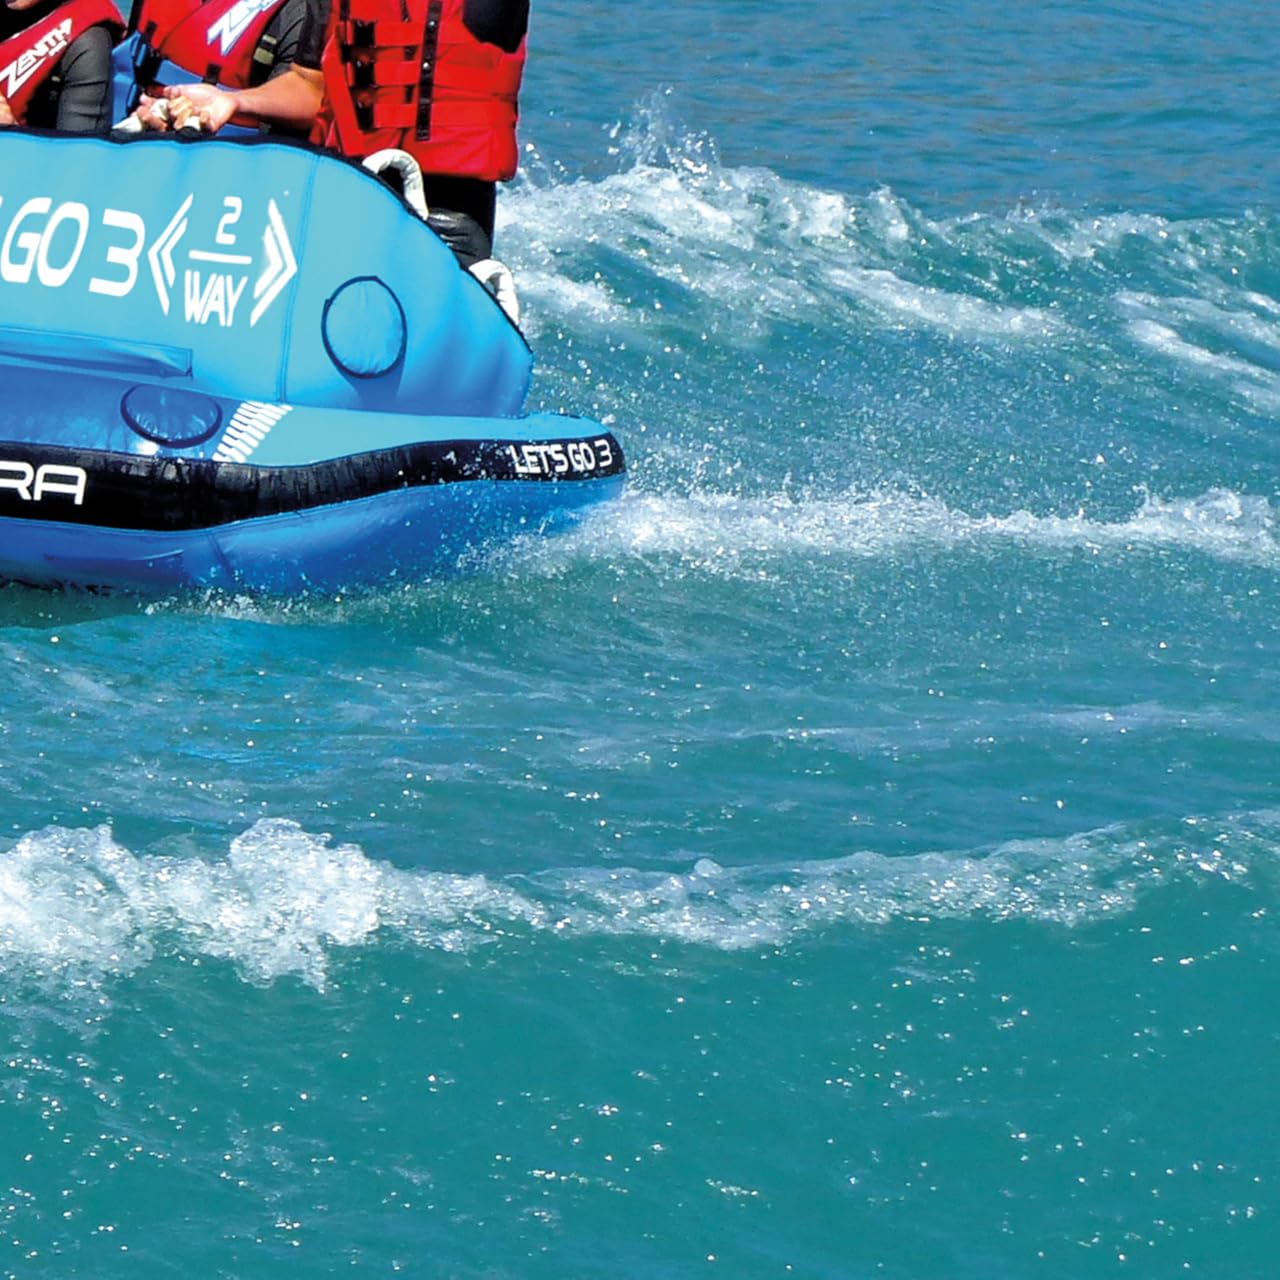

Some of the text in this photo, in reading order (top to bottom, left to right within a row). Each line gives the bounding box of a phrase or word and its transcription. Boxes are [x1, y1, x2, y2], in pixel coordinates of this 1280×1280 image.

[0, 197, 90, 287] GO
[88, 208, 146, 297] 3
[215, 196, 244, 245] 2
[184, 269, 249, 327] WAY
[567, 442, 596, 472] GO
[593, 438, 613, 468] 3
